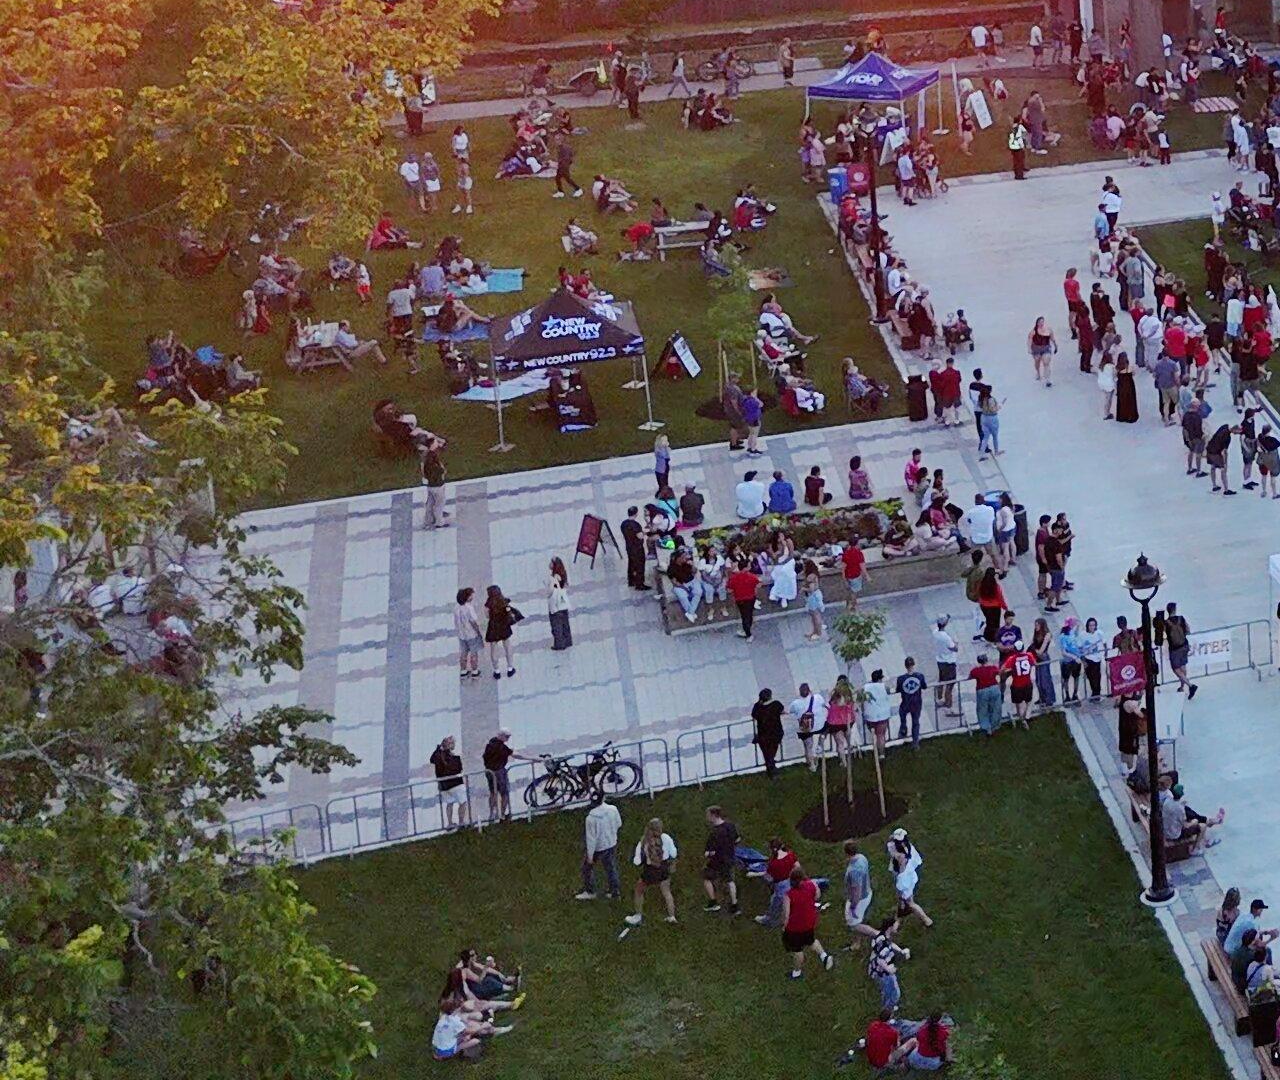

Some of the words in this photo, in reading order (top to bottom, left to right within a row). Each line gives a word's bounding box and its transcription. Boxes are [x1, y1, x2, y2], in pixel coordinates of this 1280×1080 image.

[561, 316, 586, 327] NEW
[541, 322, 602, 339] COUNTRY
[523, 357, 547, 368] NEW
[546, 351, 590, 365] COUNTRY
[1015, 659, 1031, 677] 19
